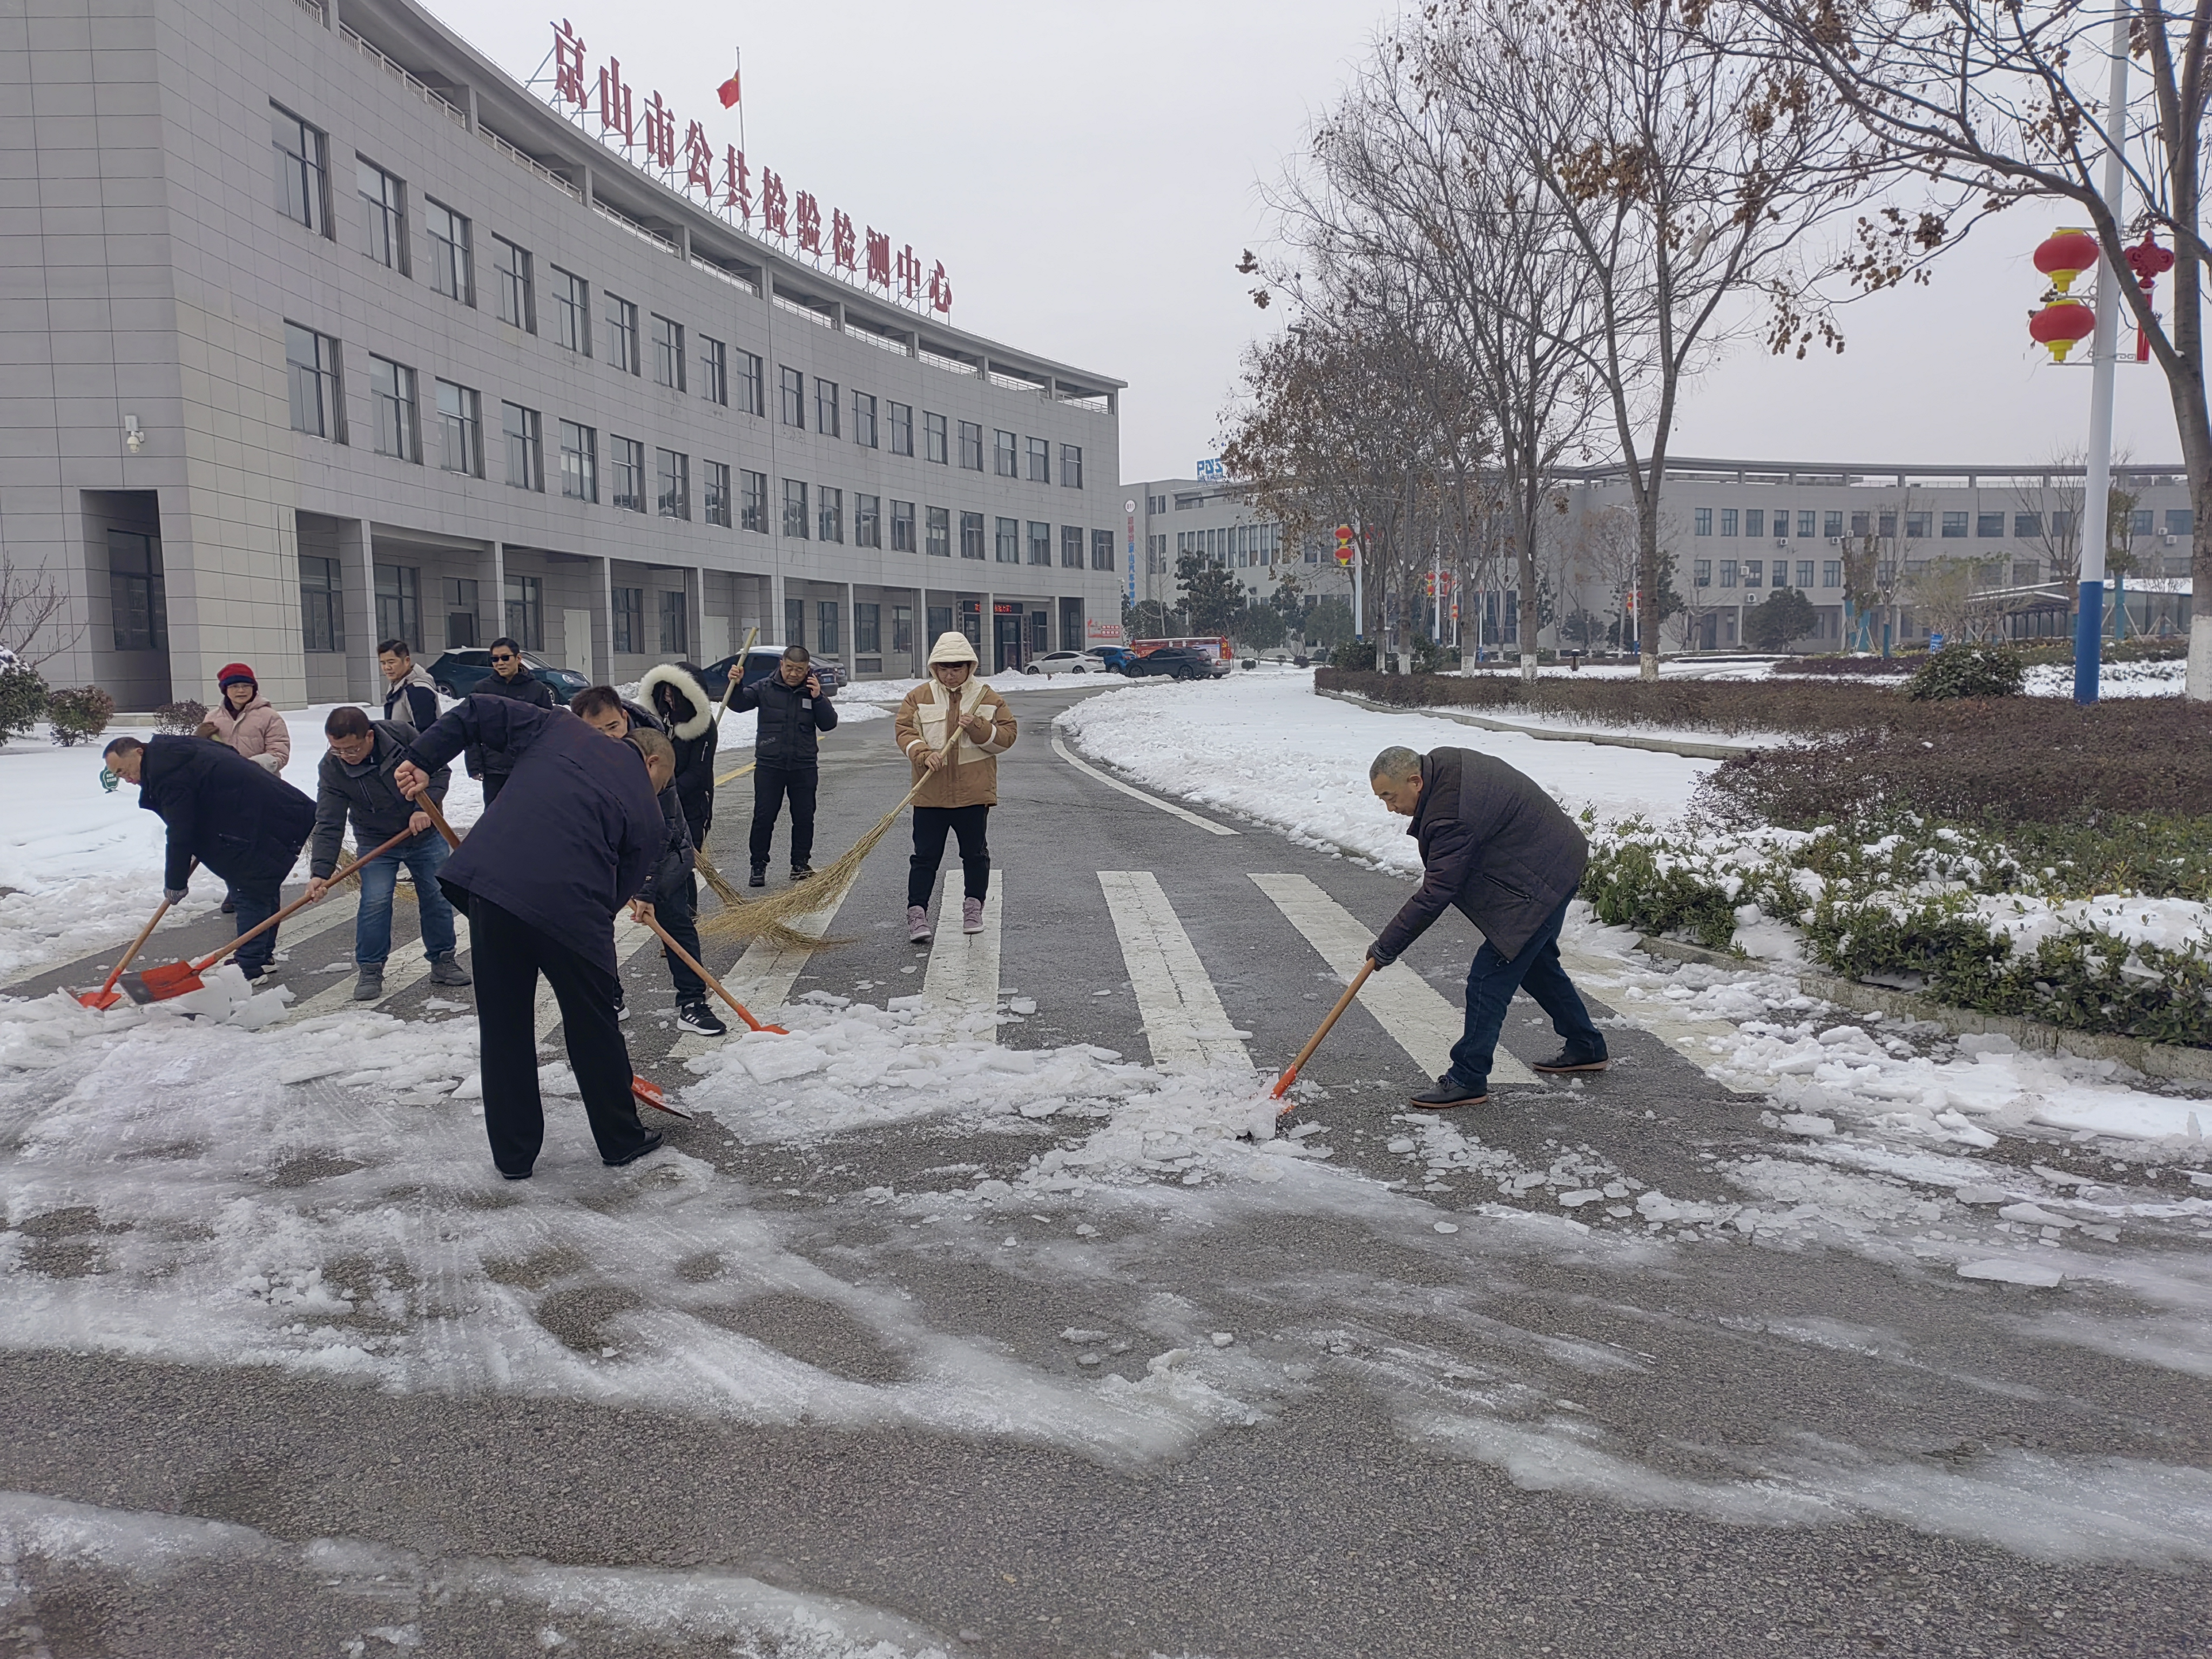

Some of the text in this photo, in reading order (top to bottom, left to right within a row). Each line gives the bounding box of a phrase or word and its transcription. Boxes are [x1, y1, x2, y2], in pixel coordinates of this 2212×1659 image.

[550, 18, 952, 313] 京山市公共检验检测中心
